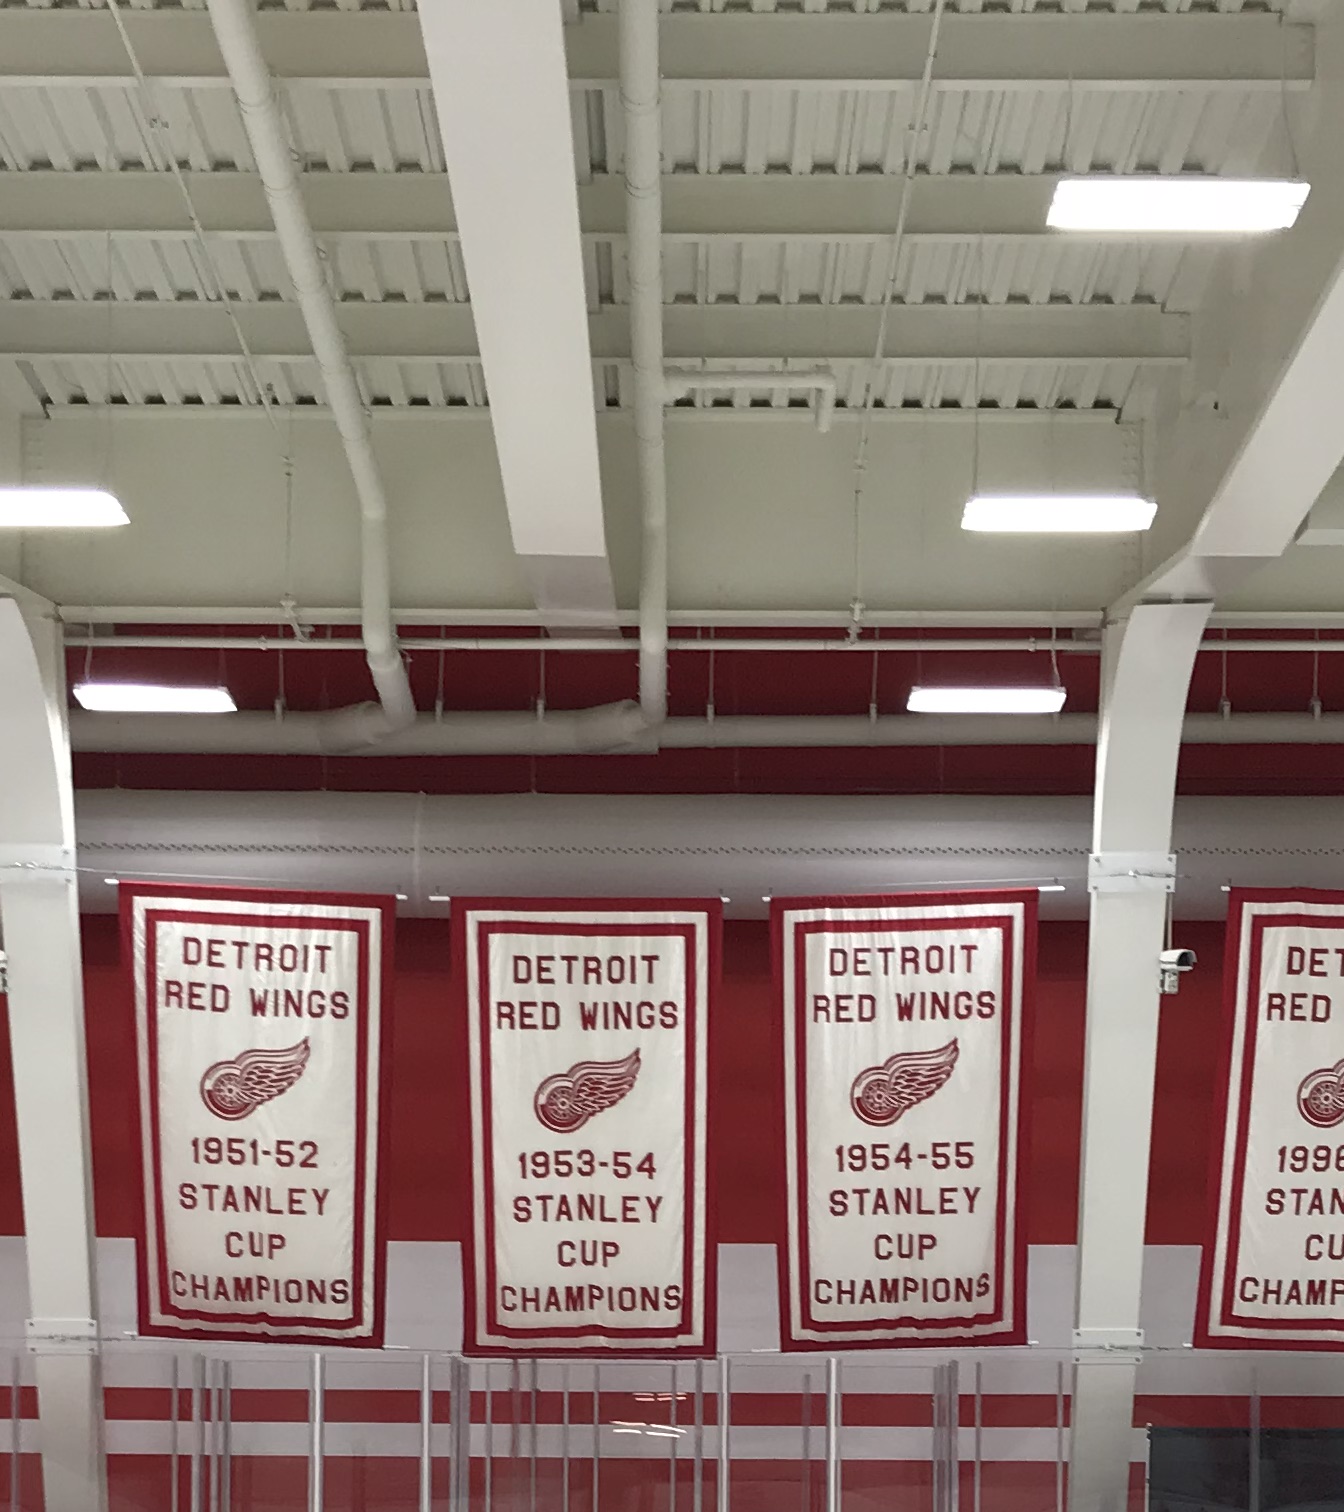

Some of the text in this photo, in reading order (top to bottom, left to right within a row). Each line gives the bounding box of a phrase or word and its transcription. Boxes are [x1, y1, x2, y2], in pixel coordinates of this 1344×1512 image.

[182, 936, 332, 974] DETROIT
[512, 954, 660, 986] DETROIT
[829, 944, 978, 977] DETROIT
[164, 979, 350, 1020] RED WINGS
[496, 1000, 678, 1031] RED WINGS
[812, 990, 996, 1024] RED WINGS
[1266, 992, 1332, 1023] RED
[191, 1136, 319, 1169] 1951-52
[518, 1149, 657, 1180] 1953-54
[835, 1141, 975, 1173] 1954-55
[178, 1182, 330, 1216] STANLEY
[512, 1193, 663, 1224] STANLEY
[829, 1186, 981, 1217] STANLEY
[225, 1231, 286, 1260] CUP
[557, 1239, 620, 1268] CUP
[874, 1233, 938, 1261] CUP
[169, 1269, 352, 1307] CHAMPIONS
[498, 1283, 683, 1314] CHAMPIONS
[814, 1272, 991, 1305] CHAMPIONS
